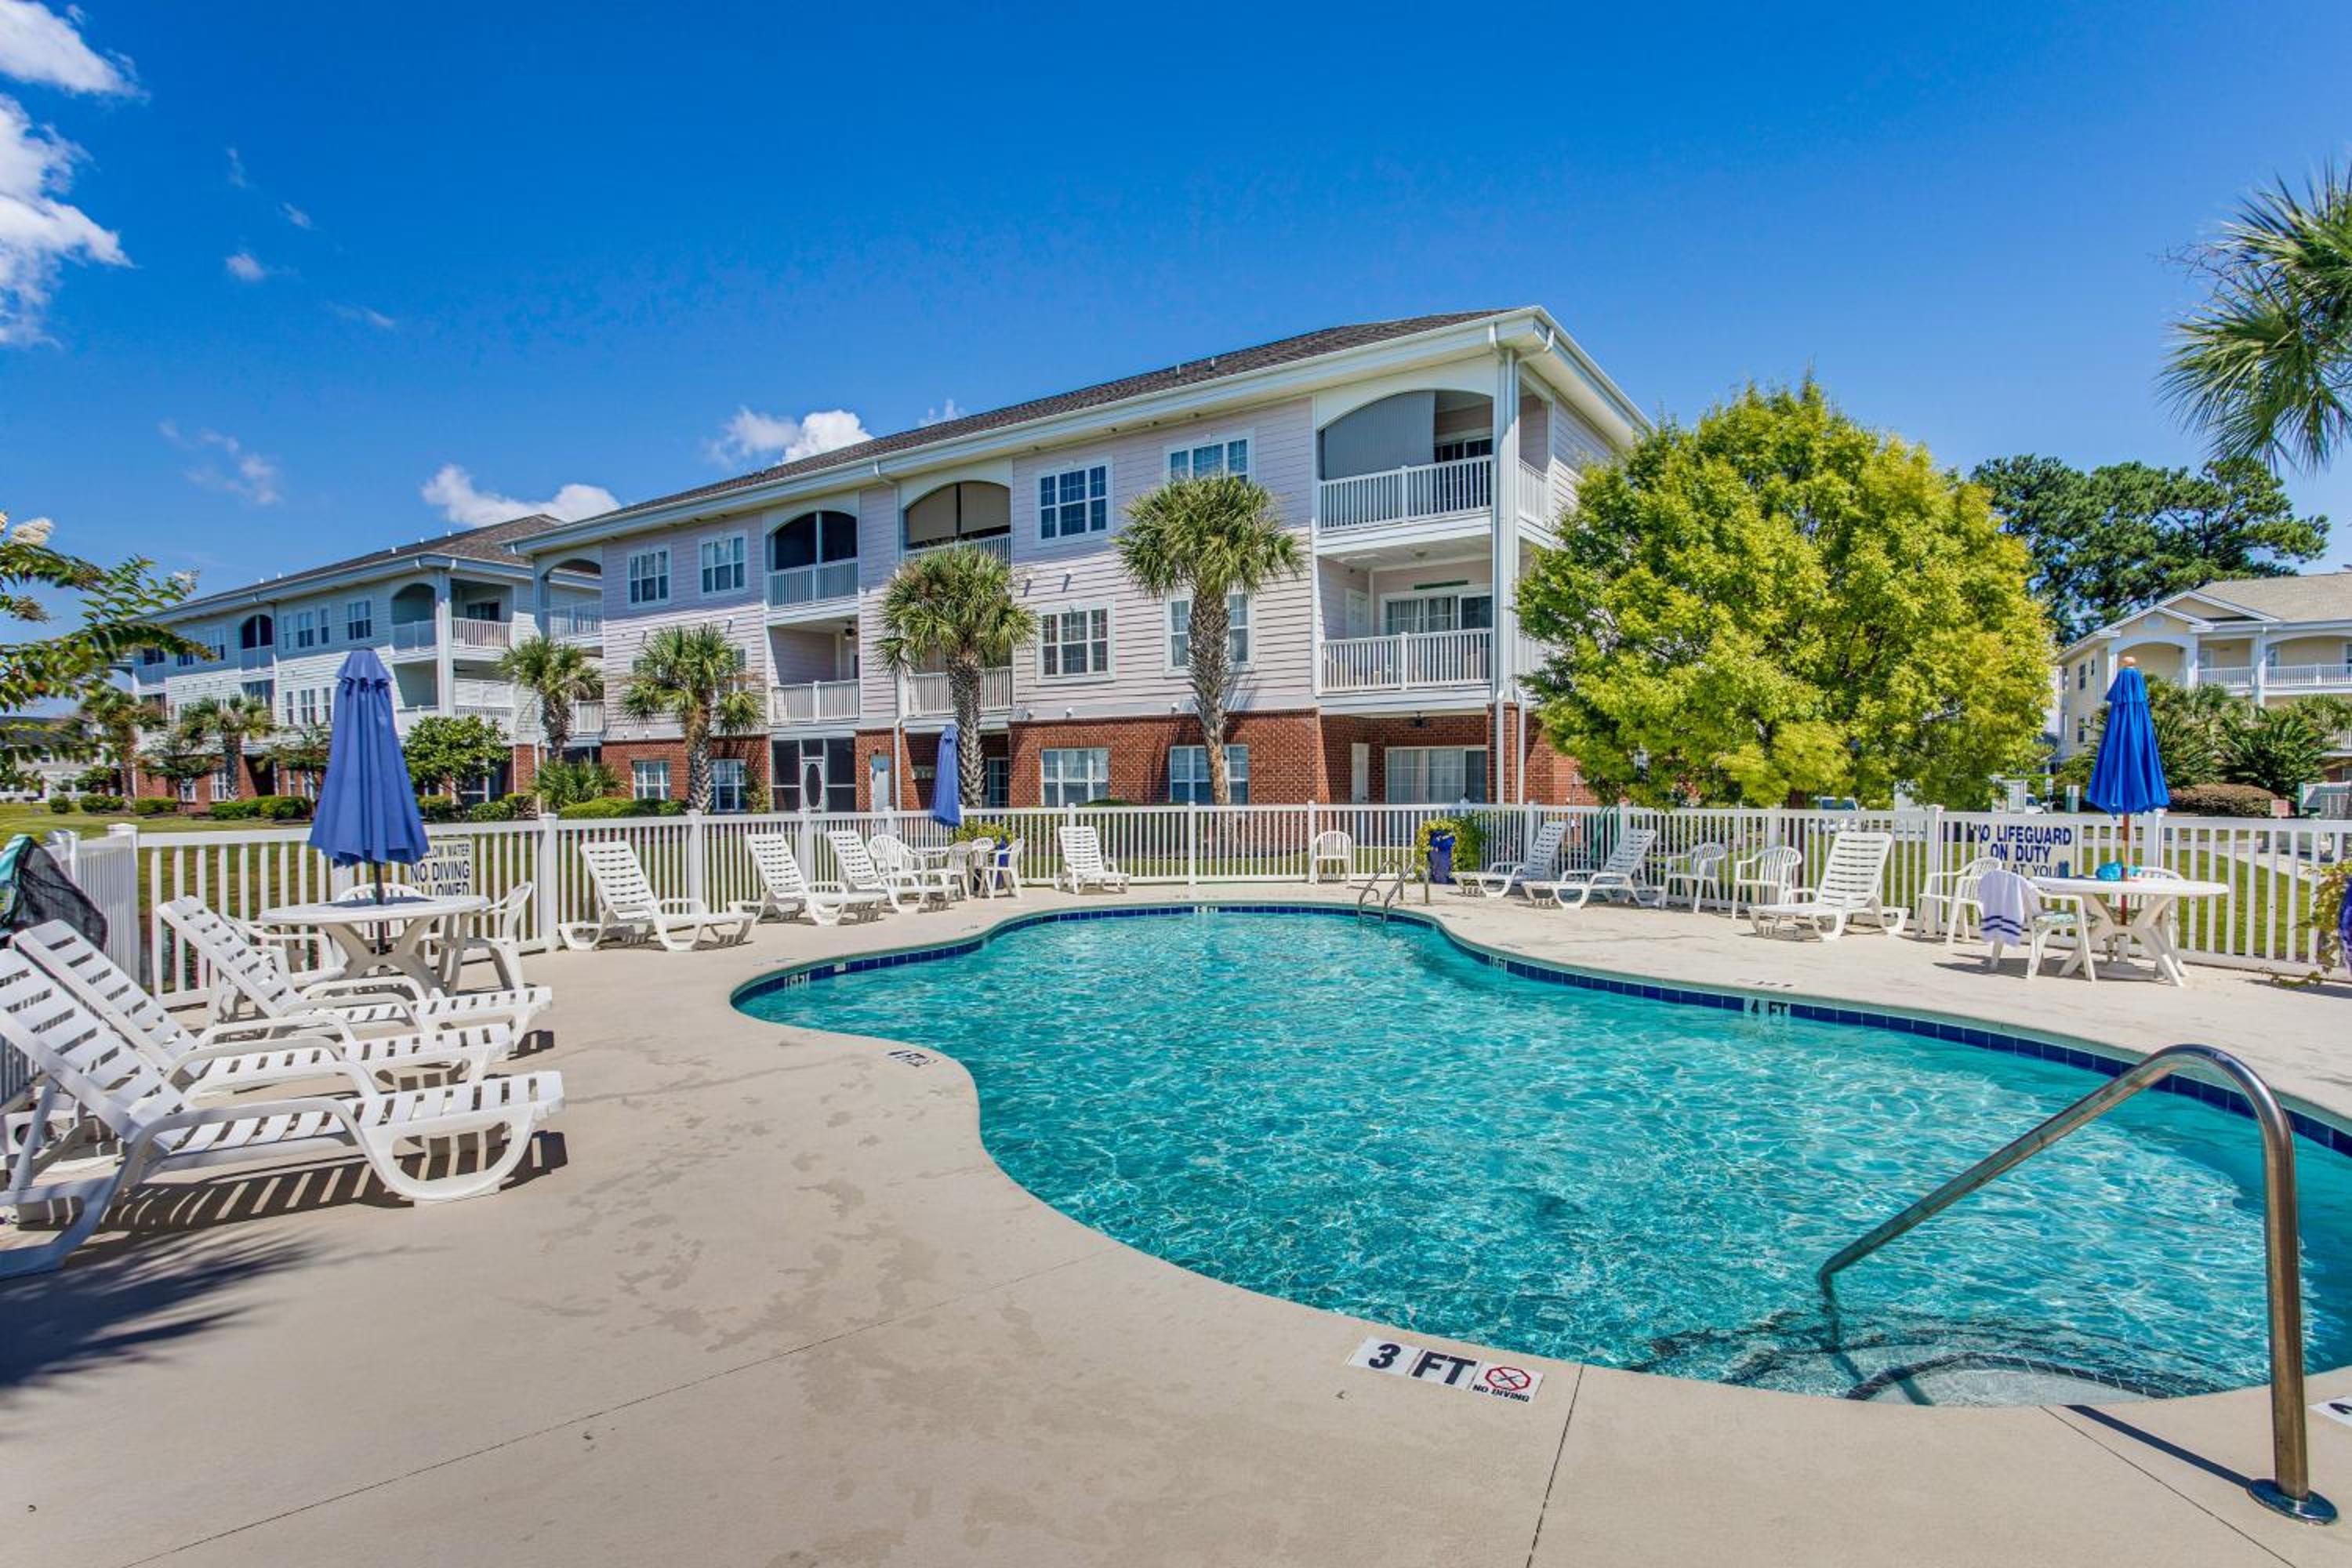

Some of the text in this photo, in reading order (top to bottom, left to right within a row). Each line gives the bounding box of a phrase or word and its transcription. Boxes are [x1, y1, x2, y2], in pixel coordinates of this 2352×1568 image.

[1997, 825, 2072, 845] LIFEGUARD
[447, 844, 470, 856] WATER
[1991, 844, 2051, 862] ON DUTY
[410, 860, 470, 884] NO DIVING
[2011, 863, 2027, 875] AT
[2031, 865, 2059, 877] YOU
[1769, 1002, 1788, 1016] FT
[1369, 1344, 1477, 1385] 3 FT
[1490, 1389, 1530, 1403] DIVING
